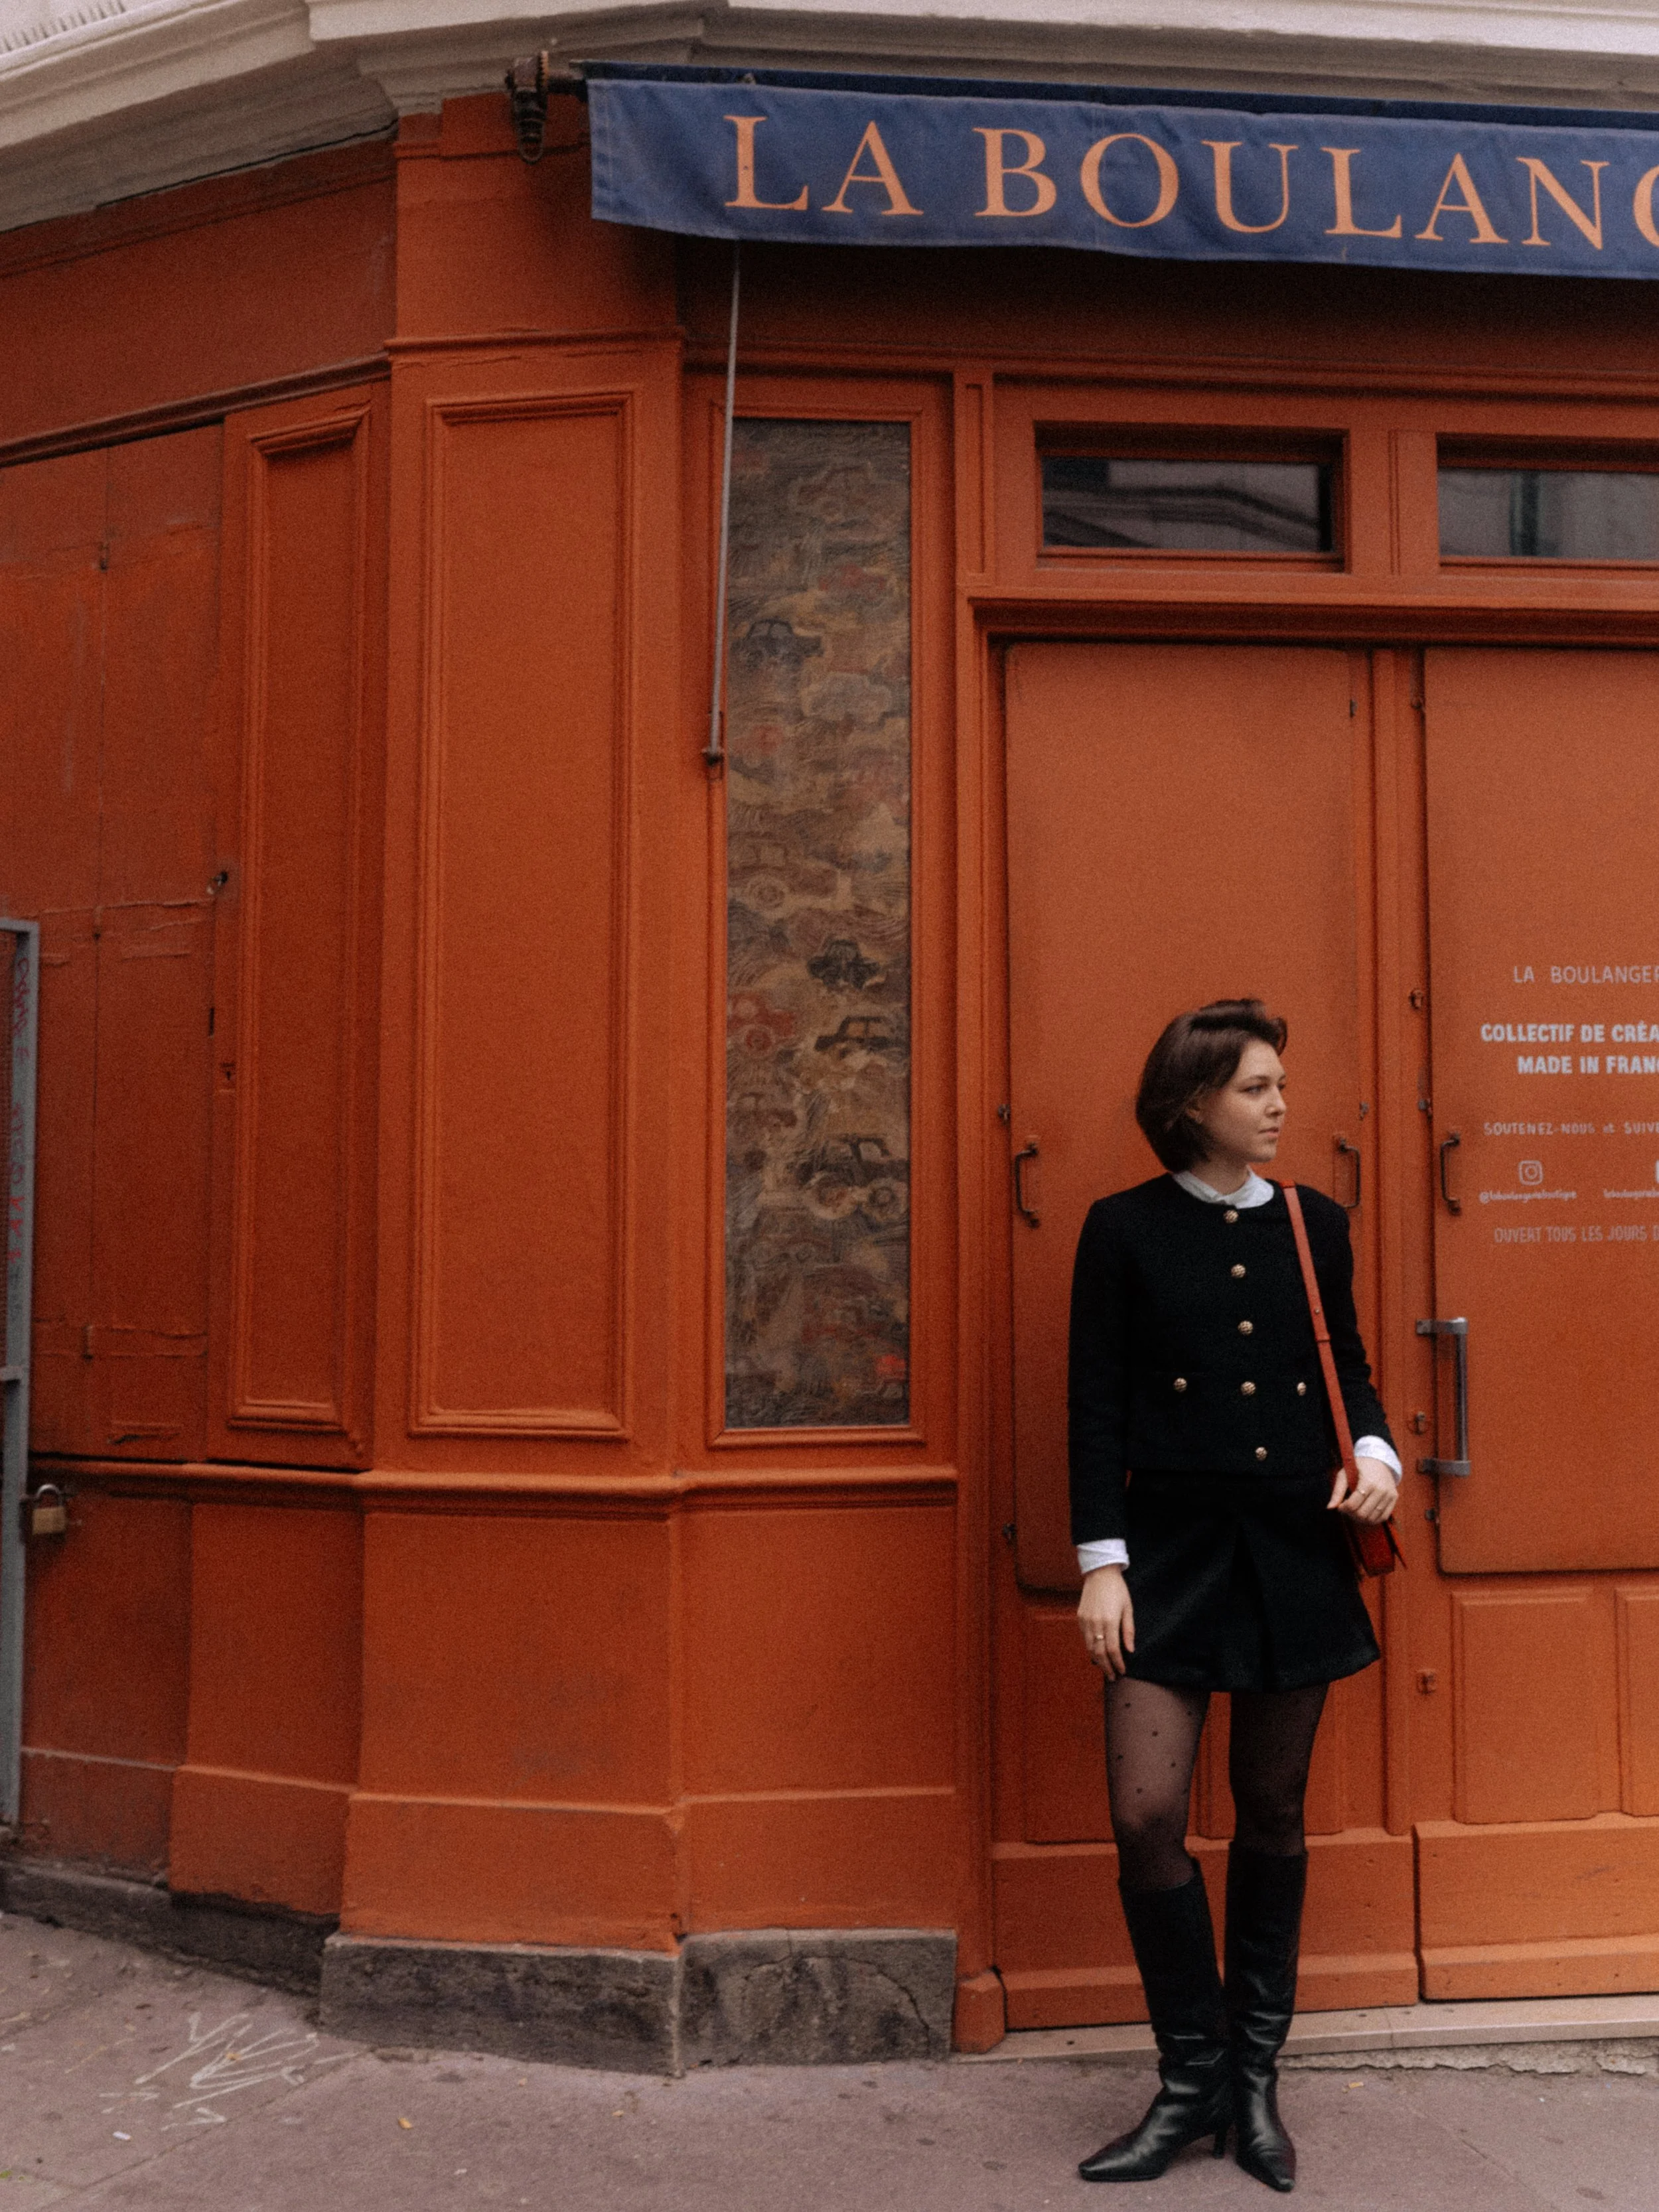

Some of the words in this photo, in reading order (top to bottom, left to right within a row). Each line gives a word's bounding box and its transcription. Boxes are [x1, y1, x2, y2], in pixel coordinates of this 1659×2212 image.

[723, 115, 924, 216] LA
[1513, 965, 1535, 983] LA
[1480, 1023, 1575, 1043] COLLECTIF
[1580, 1024, 1605, 1043] DE
[1517, 1056, 1573, 1074] MADE
[1580, 1056, 1600, 1074] IN
[1606, 1055, 1659, 1074] FRAN
[1494, 1227, 1542, 1243] OUVERT
[1546, 1225, 1577, 1243] TOUS
[1581, 1225, 1603, 1242] LES
[1608, 1225, 1648, 1242] JOURS
